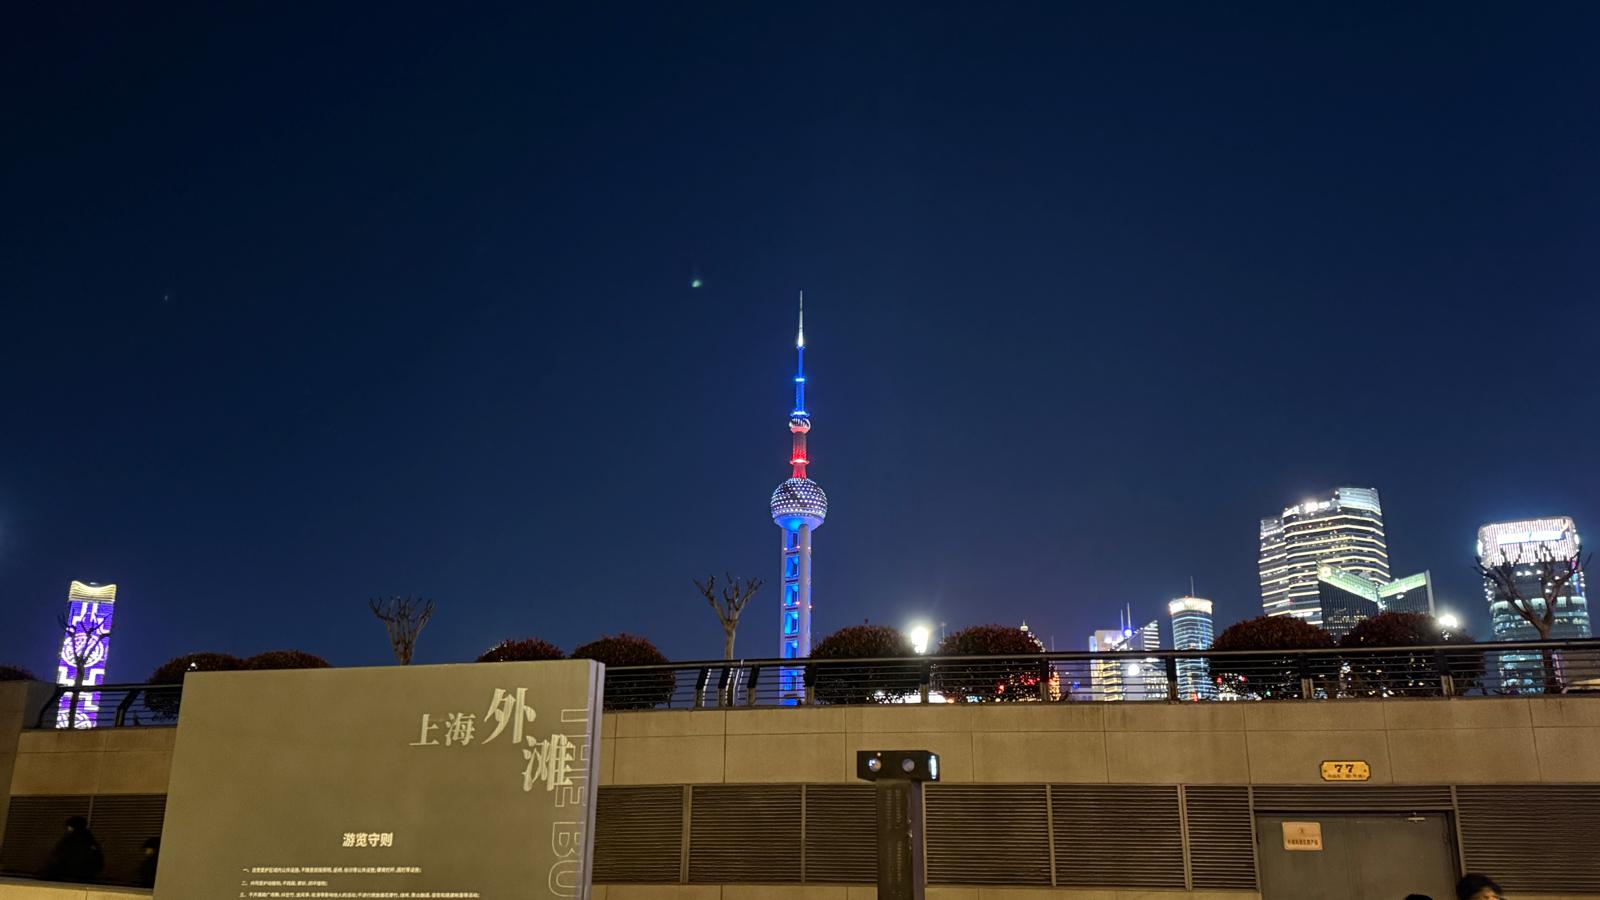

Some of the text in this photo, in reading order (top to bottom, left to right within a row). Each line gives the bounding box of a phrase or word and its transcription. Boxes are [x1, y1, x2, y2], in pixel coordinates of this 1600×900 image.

[409, 686, 574, 792] 上海 外滩
[1334, 764, 1354, 773] 77
[342, 832, 394, 848] 游览守则
